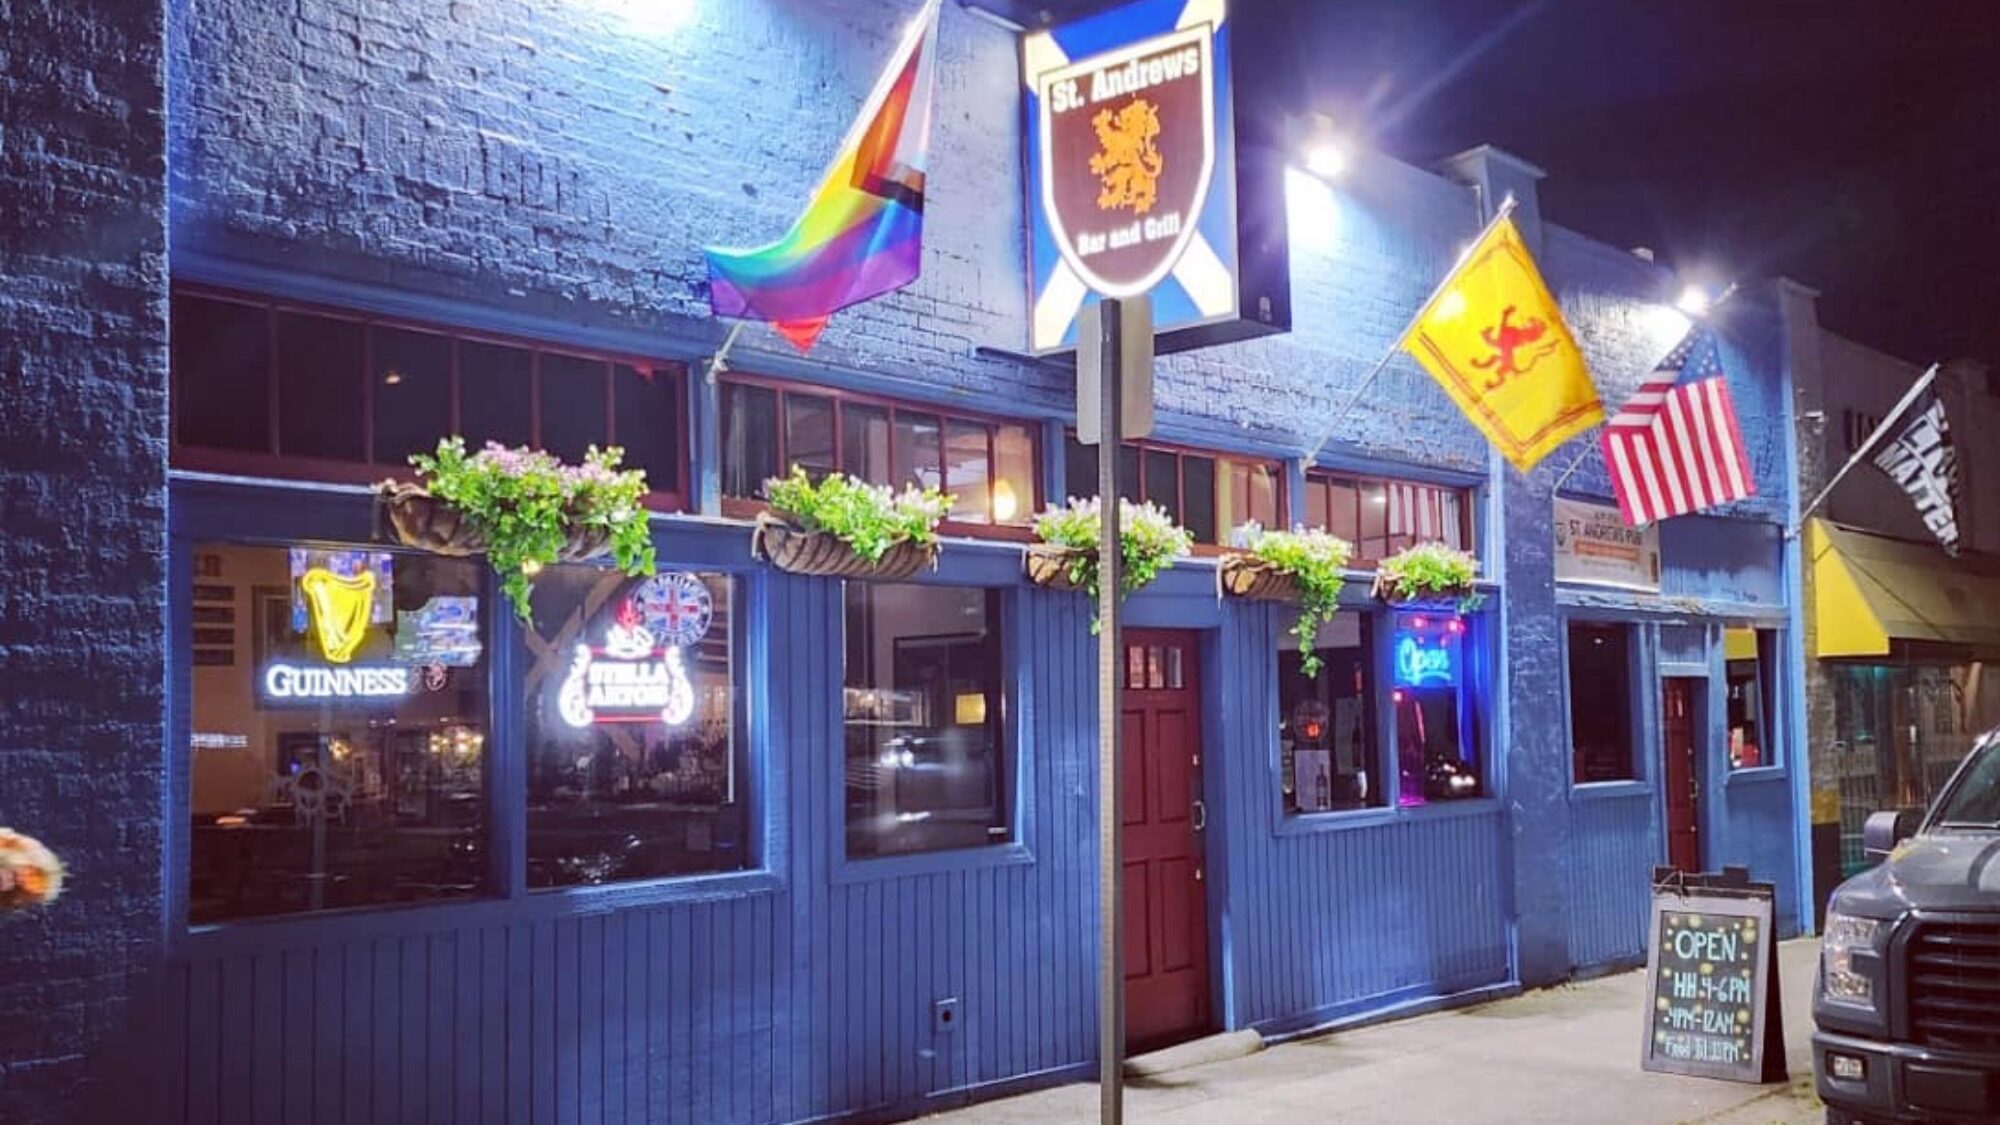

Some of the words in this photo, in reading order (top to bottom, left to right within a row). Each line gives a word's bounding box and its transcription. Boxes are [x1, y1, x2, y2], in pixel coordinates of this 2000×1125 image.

[1052, 79, 1085, 113] St.
[1091, 47, 1199, 103] Andrews
[1078, 233, 1107, 257] Bar
[1109, 222, 1140, 251] and
[1144, 213, 1181, 239] Grill
[587, 662, 670, 685] STELLA
[1400, 636, 1451, 685] Open
[266, 664, 407, 697] GUINNESS
[1674, 929, 1737, 963] OPEN
[1673, 971, 1697, 999] HH
